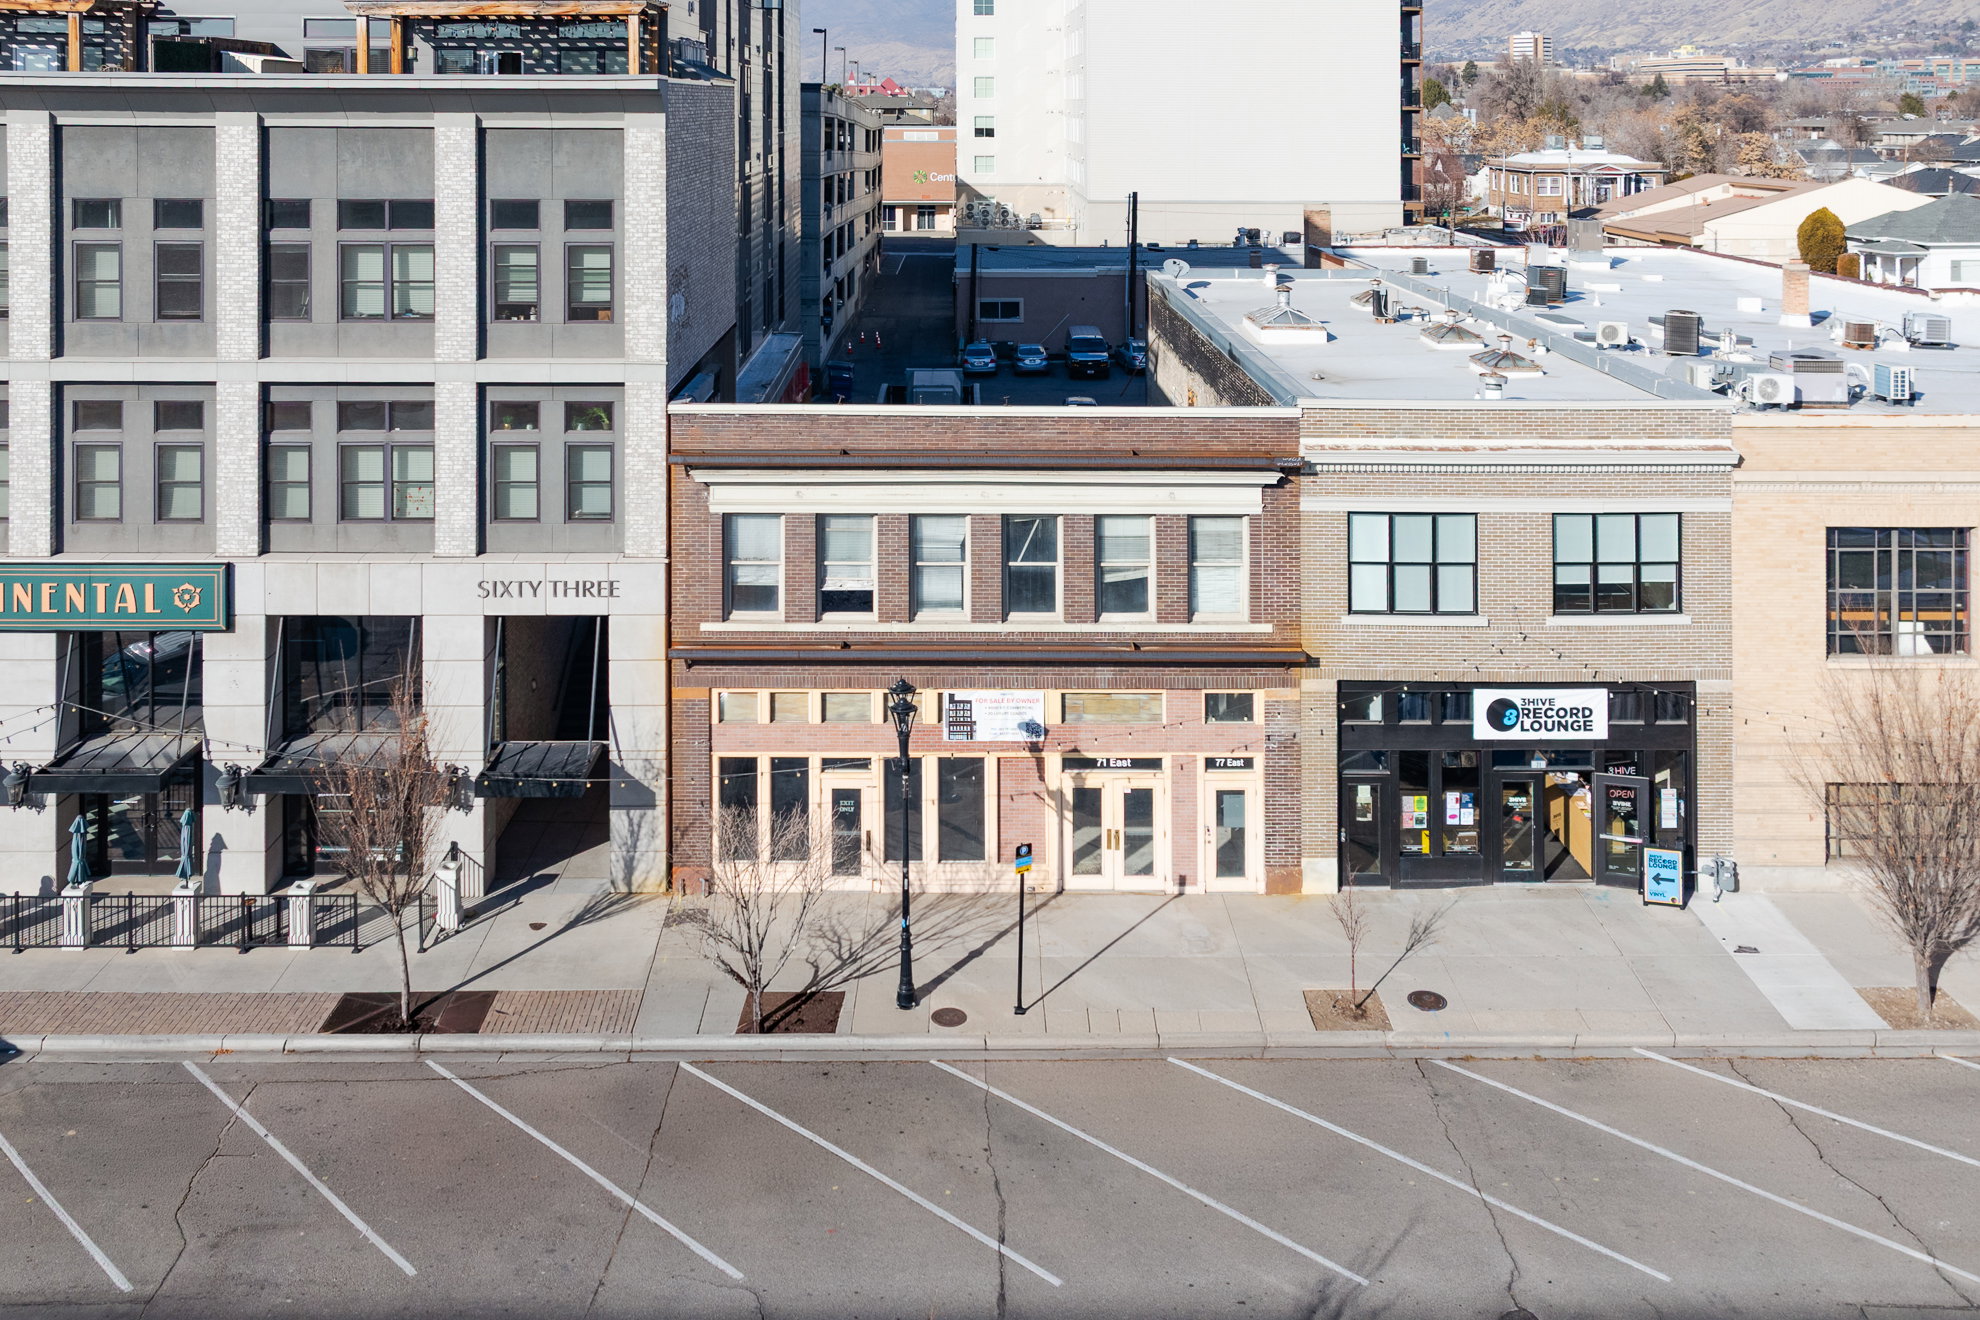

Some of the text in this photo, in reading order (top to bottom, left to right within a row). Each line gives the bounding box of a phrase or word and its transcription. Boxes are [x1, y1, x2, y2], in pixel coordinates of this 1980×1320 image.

[477, 580, 621, 599] SIXTY THREE
[1521, 698, 1555, 706] 3HIVE
[1521, 707, 1593, 719] RECORD
[1520, 720, 1593, 732] LOUNGE
[1096, 758, 1132, 767] 71 East
[1215, 758, 1244, 767] 77 East
[1609, 789, 1635, 799] OPEN
[1648, 857, 1678, 866] RECORD
[1648, 863, 1678, 871] LOUNGE
